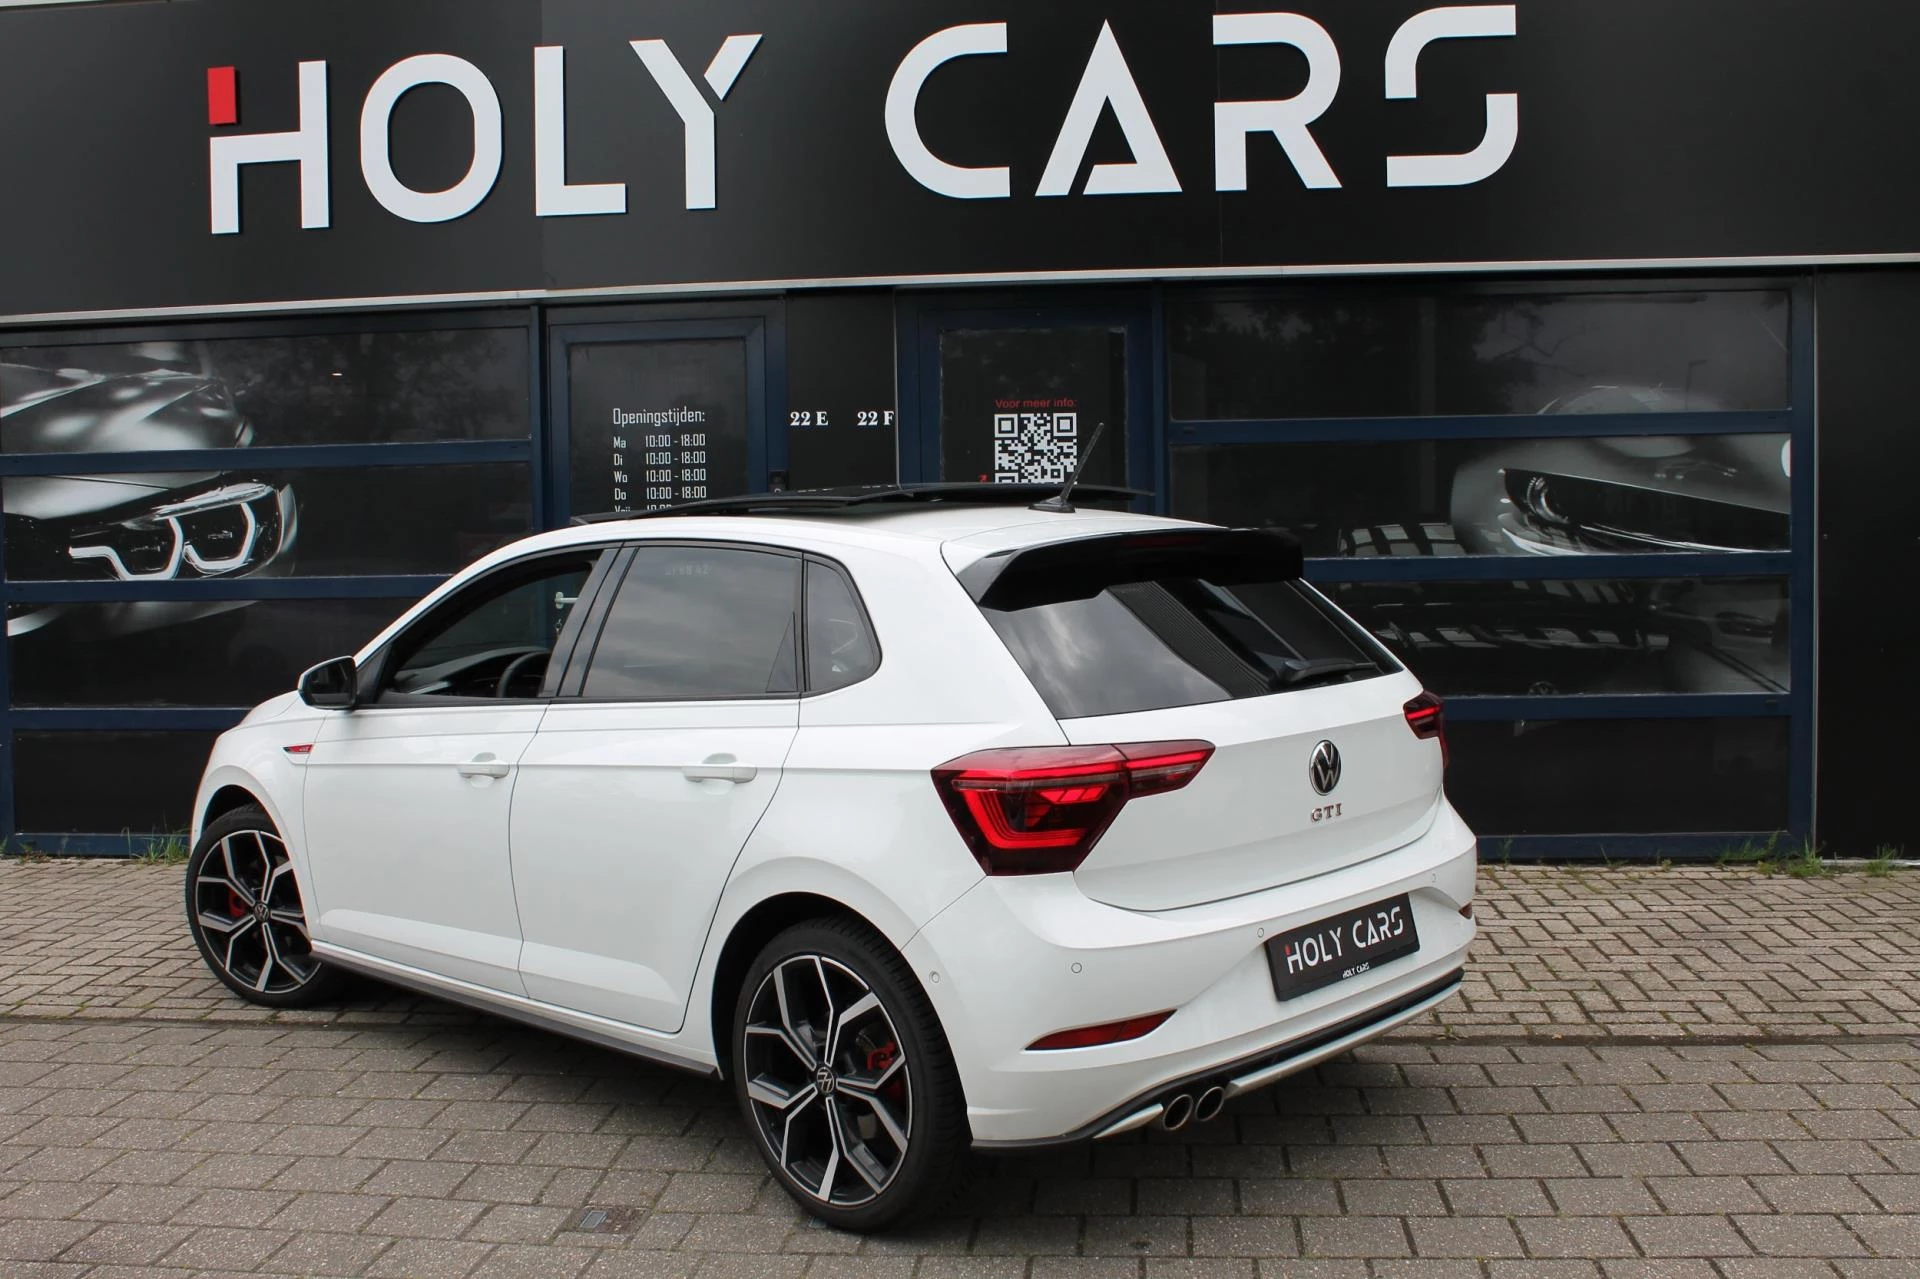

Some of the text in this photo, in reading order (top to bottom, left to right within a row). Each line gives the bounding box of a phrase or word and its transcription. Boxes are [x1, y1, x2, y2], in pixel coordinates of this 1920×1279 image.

[207, 4, 1519, 235] HOLY CARS
[995, 399, 1020, 408] Voor
[1023, 399, 1051, 408] meer
[613, 406, 706, 428] Openingstijden:
[790, 411, 829, 426] 22 E
[857, 410, 894, 426] 22 F
[613, 436, 626, 448] Ma
[646, 434, 671, 448] 10:00
[681, 434, 706, 446] 18:00
[614, 454, 623, 466] Di
[646, 452, 671, 464] 10:00
[681, 451, 706, 464] 18:00
[614, 471, 628, 483] Wo
[646, 470, 671, 482] 10:00
[682, 468, 706, 481] 18:00
[614, 488, 626, 500] Do
[646, 487, 672, 500] 10:00
[682, 486, 706, 498] 18:00
[1311, 803, 1342, 822] GTI
[1284, 906, 1404, 974] HOLY CARS
[1342, 962, 1370, 979] HOLY CARS
